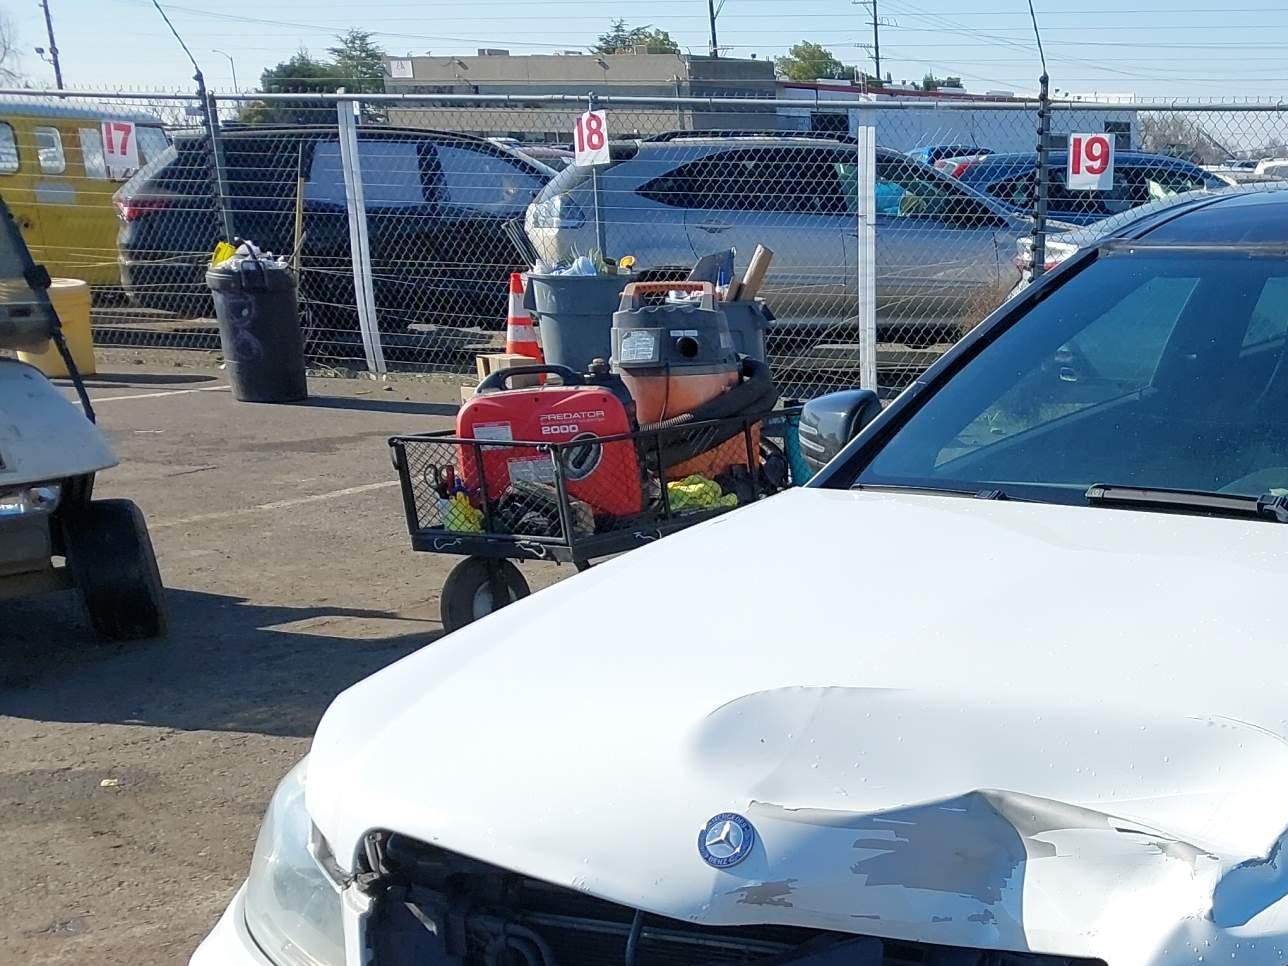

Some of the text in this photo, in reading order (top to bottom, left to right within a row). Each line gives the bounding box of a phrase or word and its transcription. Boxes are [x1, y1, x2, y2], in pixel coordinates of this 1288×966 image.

[105, 121, 132, 156] 17
[576, 113, 605, 153] 18
[1071, 136, 1110, 175] 19
[540, 410, 605, 421] PREDATOR
[541, 424, 579, 435] 2000
